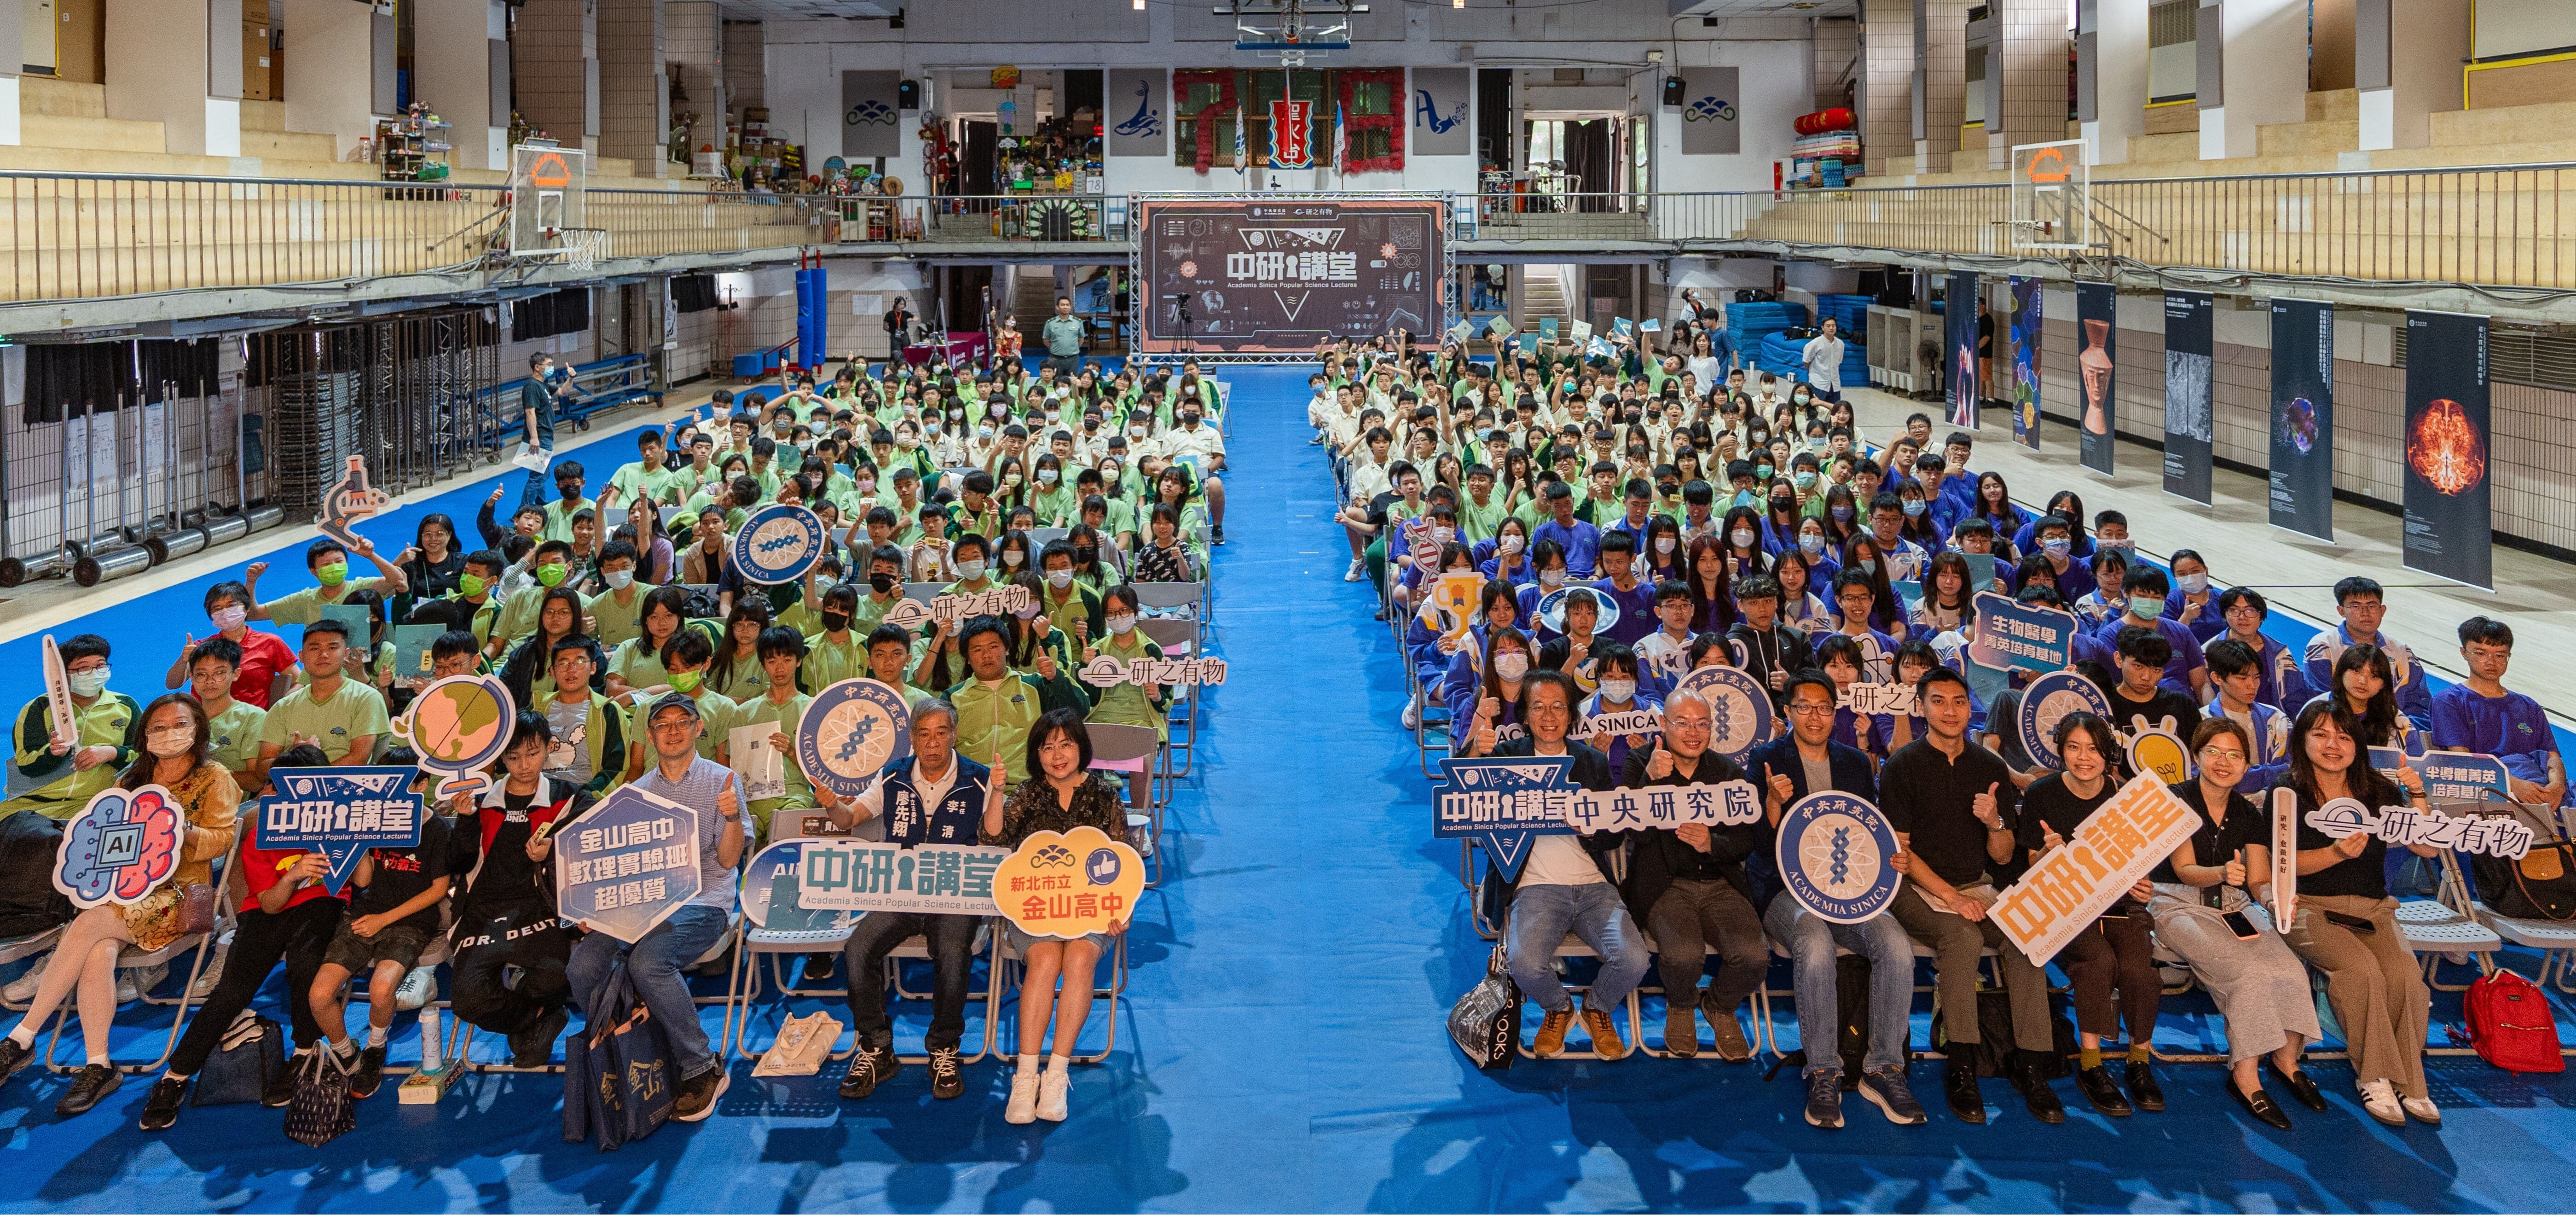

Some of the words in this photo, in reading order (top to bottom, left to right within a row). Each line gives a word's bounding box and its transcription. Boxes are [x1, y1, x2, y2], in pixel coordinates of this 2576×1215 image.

[1227, 251, 1357, 280] 中研講堂
[739, 519, 759, 561] ACADEMIA
[743, 560, 769, 579] SINICA
[933, 587, 1026, 621] 研之有物
[1992, 615, 2056, 644] 生物醫學
[1984, 634, 2062, 666] 菁英培育基地
[1129, 659, 1225, 684] 研之有物
[845, 686, 907, 732] 中央研究院
[1598, 715, 1658, 733] SINICA
[2025, 702, 2043, 756] ACADEMIA
[804, 732, 834, 788] ACADEMIA
[838, 779, 873, 792] SINIC
[1734, 738, 1765, 764] SINCA
[826, 760, 851, 776] 1928
[2425, 766, 2496, 784] 半導體菁英
[266, 799, 414, 833] 中研講堂
[892, 790, 910, 837] 廖先翔
[959, 801, 967, 814] 主任
[1441, 790, 1573, 822] 中研講堂
[1573, 786, 1754, 827] 中央研究院
[1802, 800, 1879, 832] 中央研究院
[107, 835, 133, 855] AI
[580, 818, 674, 854] 金山高中
[2381, 810, 2530, 856] 研之有物
[569, 844, 689, 886] 數理實驗班
[806, 848, 1004, 898] 中研講堂
[1997, 778, 2186, 945] 中研講堂
[595, 876, 666, 912] 超優質
[1011, 874, 1072, 892] 新北市立
[1789, 870, 1847, 915] ACADEMIA
[1850, 885, 1888, 914] SINICA
[1826, 886, 1854, 898] 1928
[2034, 923, 2075, 959] Academia
[2072, 903, 2099, 925] Sinica
[2097, 875, 2130, 906] Popular
[2128, 848, 2161, 878] Science
[2159, 817, 2195, 850] Lectures
[805, 895, 851, 906] Academia
[854, 896, 882, 906] Sinica
[886, 897, 920, 909] Popular
[924, 899, 961, 909] Science
[1022, 891, 1123, 920] 金山高中
[1494, 1014, 1509, 1060] OOKS
